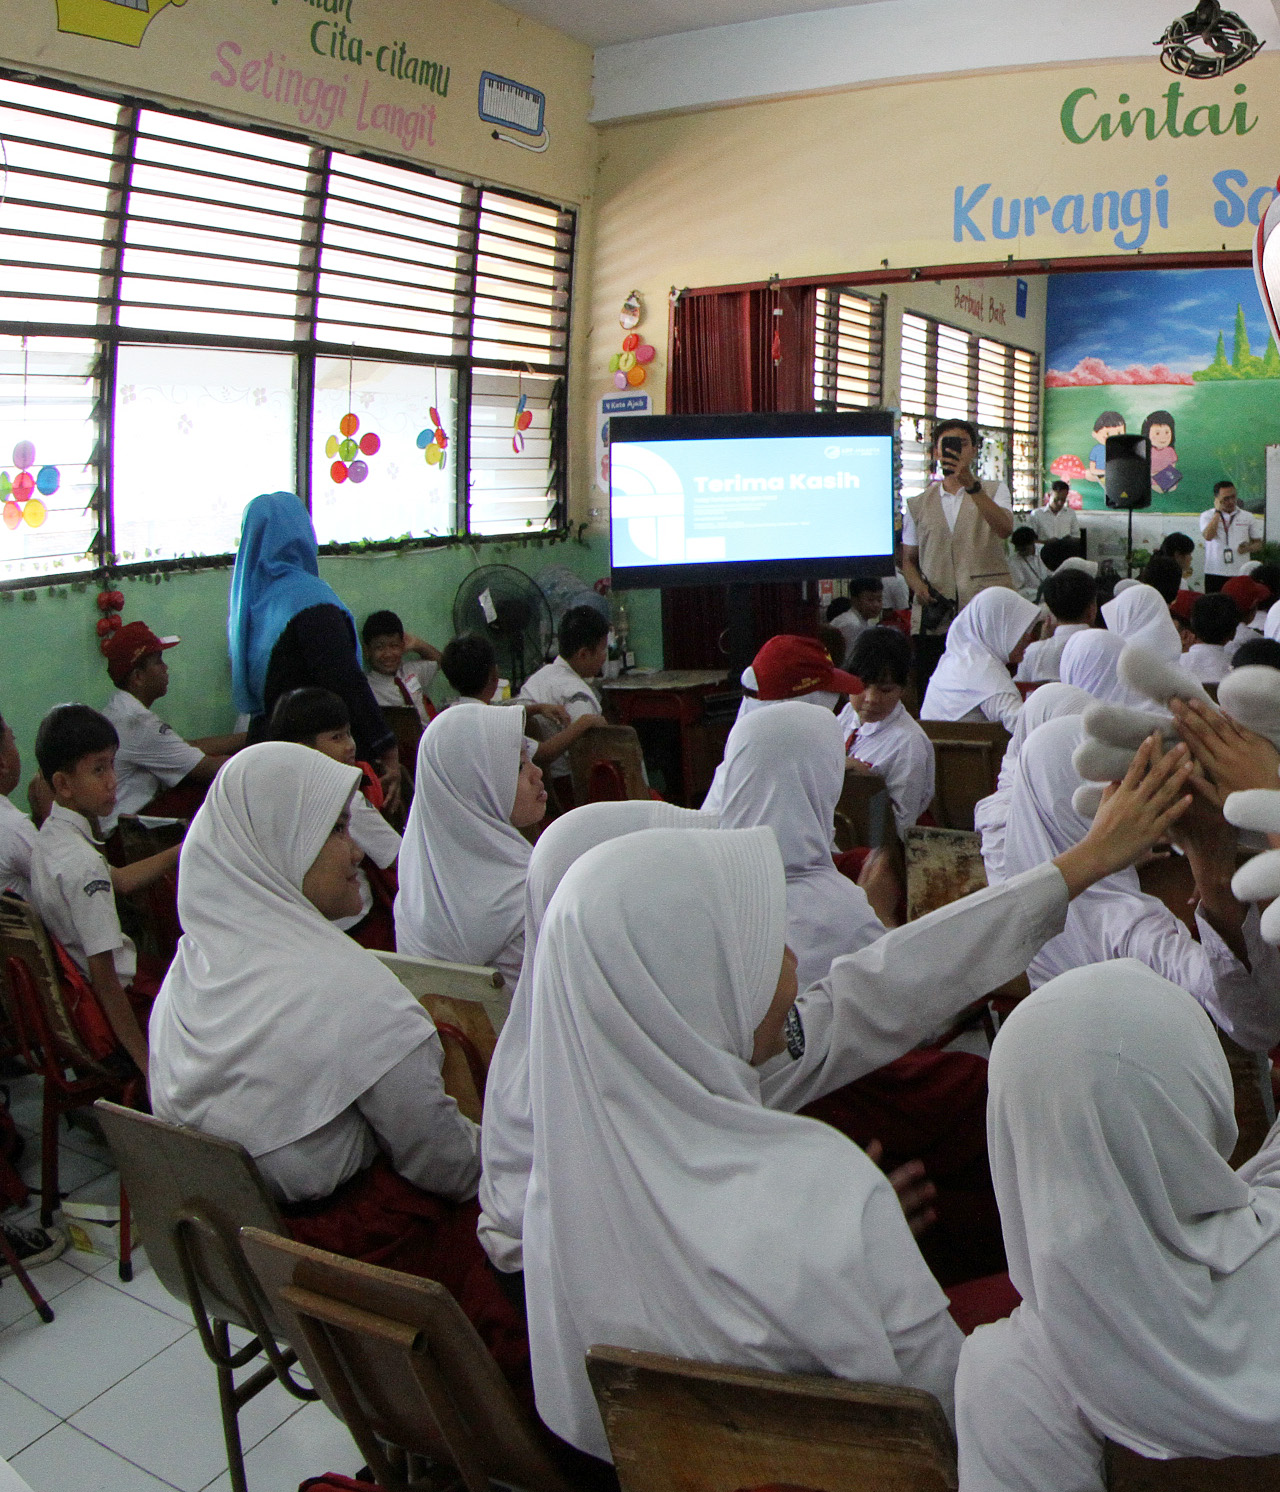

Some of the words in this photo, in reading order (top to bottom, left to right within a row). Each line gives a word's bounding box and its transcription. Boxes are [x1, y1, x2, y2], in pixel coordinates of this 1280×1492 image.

[210, 40, 350, 130] Setinggi
[356, 79, 438, 151] Langit
[310, 20, 450, 97] Cita-citamu
[1060, 81, 1259, 145] Cintai
[952, 174, 1169, 250] Kurangi
[693, 473, 785, 493] Terima
[789, 471, 861, 490] Kasih
